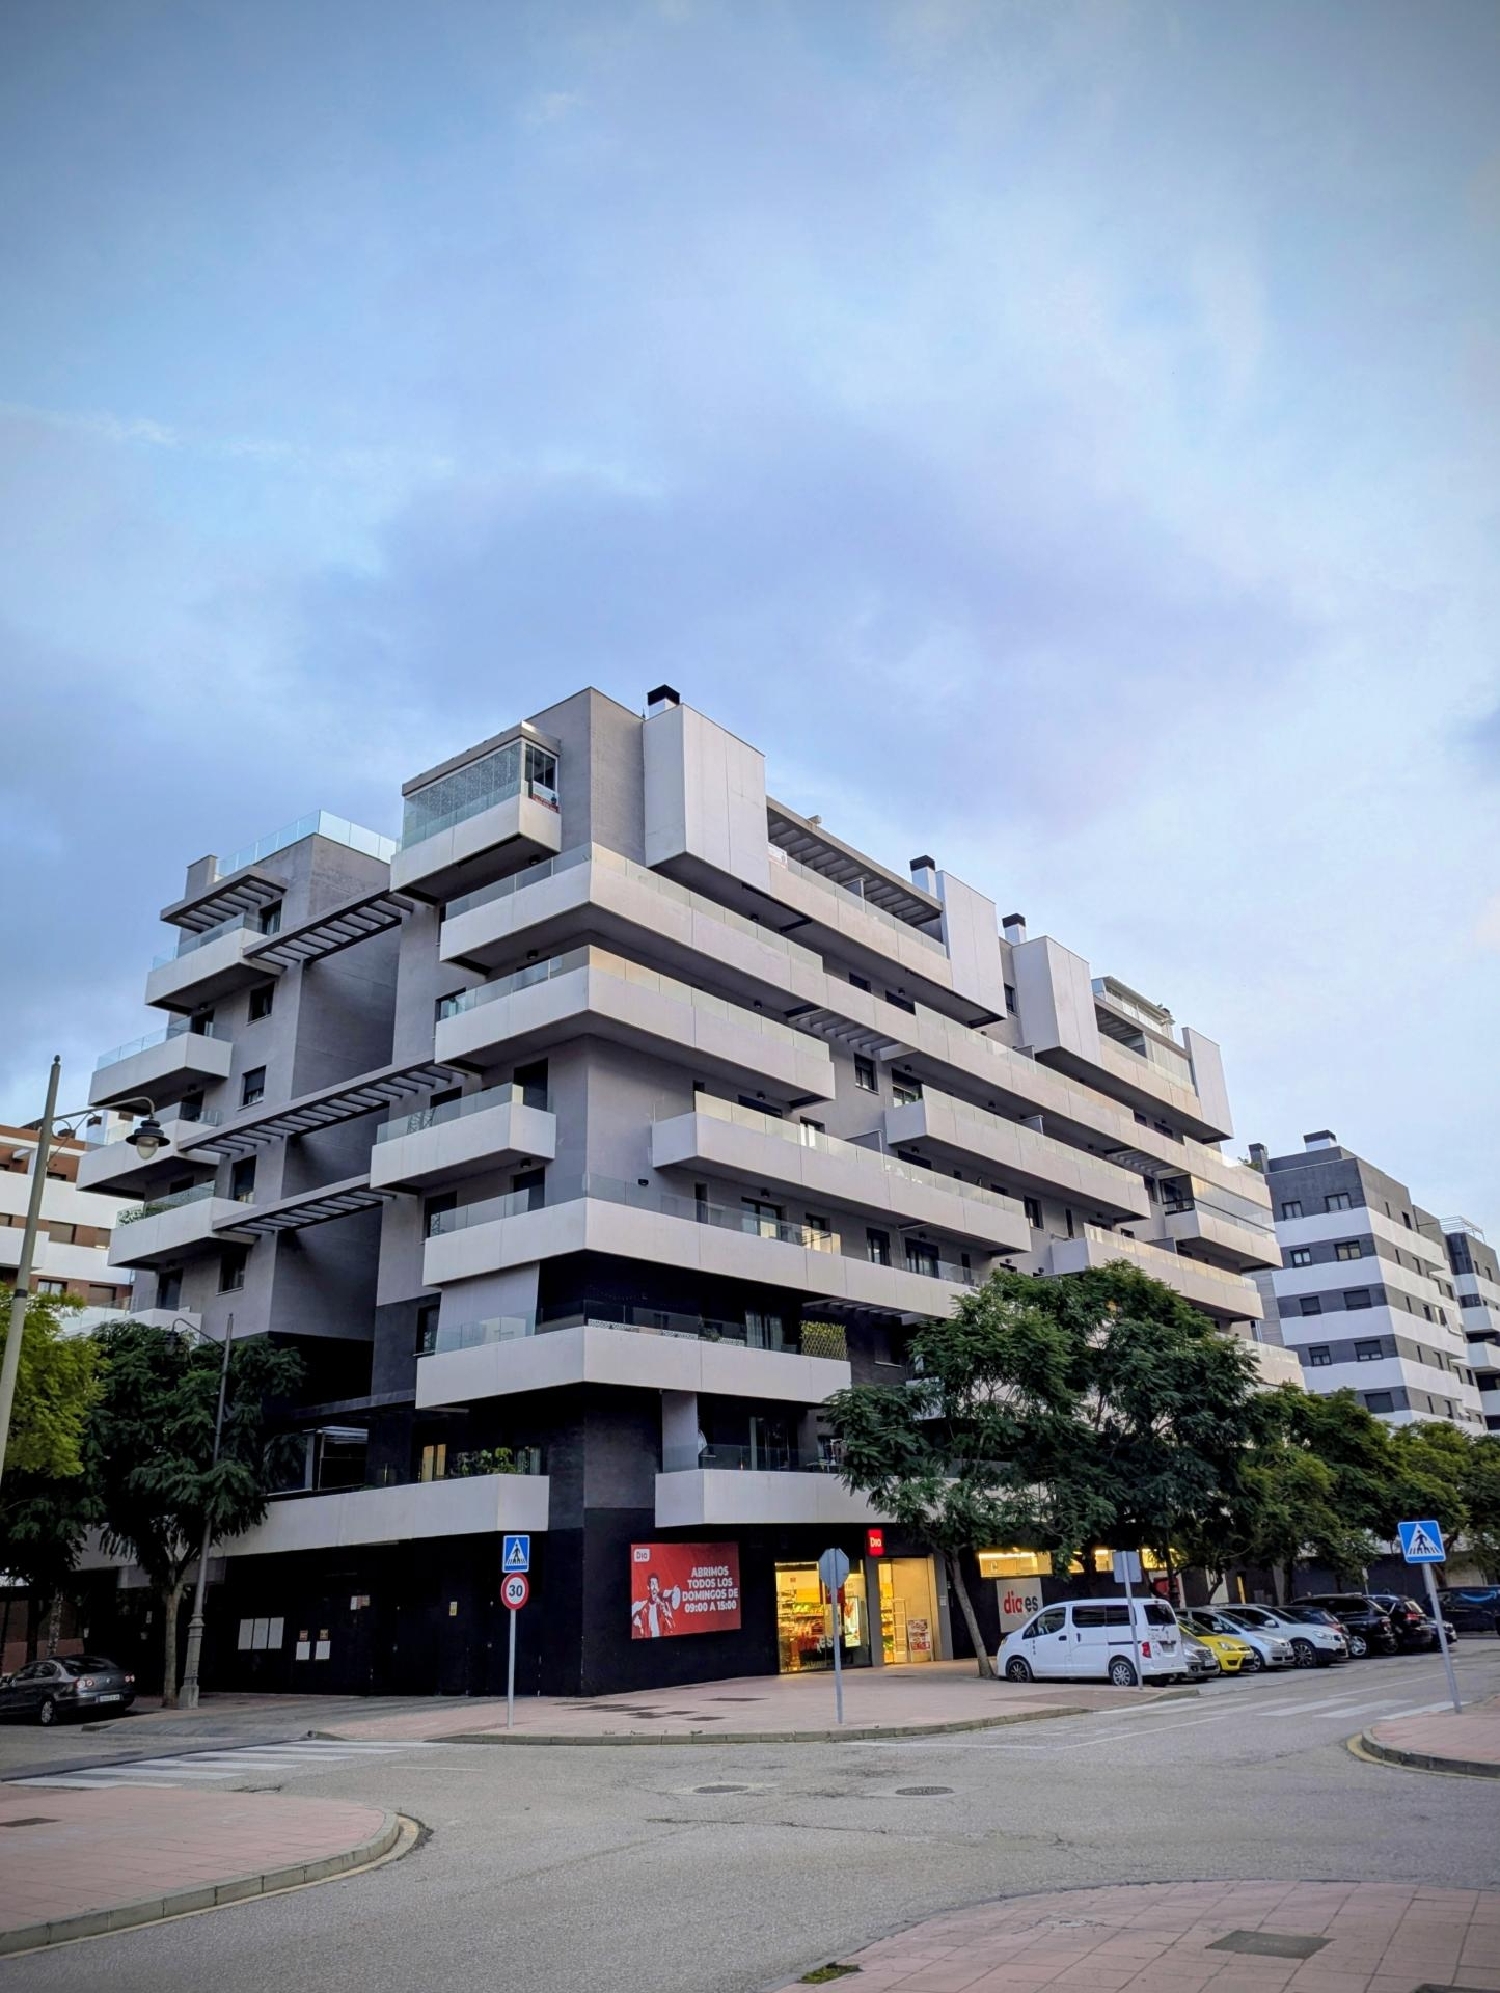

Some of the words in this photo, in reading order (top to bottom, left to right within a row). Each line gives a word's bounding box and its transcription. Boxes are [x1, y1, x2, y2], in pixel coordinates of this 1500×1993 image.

[691, 1566, 729, 1577] ABRIMOS
[687, 1579, 716, 1589] TODOS
[717, 1578, 733, 1587] LOS
[509, 1585, 523, 1596] 30
[682, 1590, 727, 1601] DOMINGOS
[728, 1588, 739, 1598] DE
[685, 1603, 708, 1613] 09:00
[709, 1602, 716, 1611] A
[717, 1600, 737, 1610] 15:00
